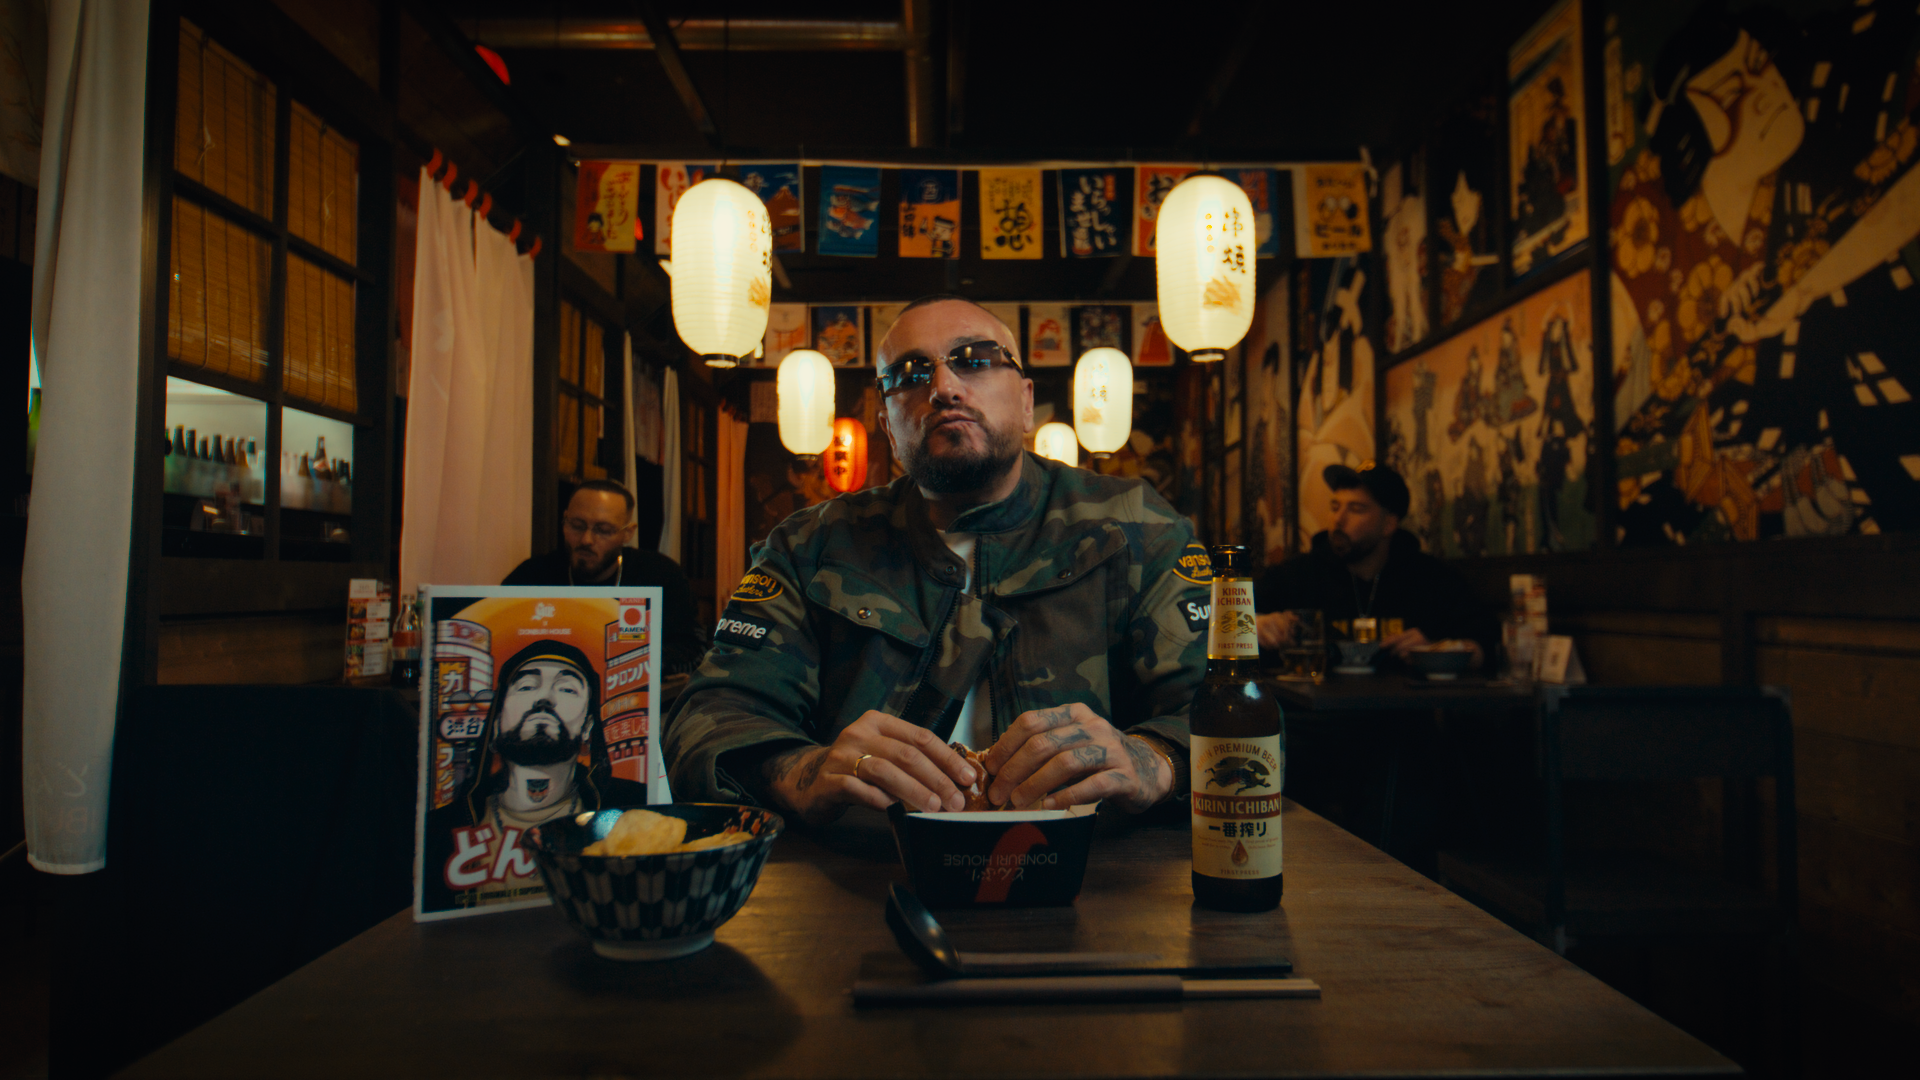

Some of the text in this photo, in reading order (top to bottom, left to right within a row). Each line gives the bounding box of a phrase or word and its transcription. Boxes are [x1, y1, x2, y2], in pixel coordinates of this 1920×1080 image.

[1222, 588, 1247, 596] KIRIN
[1218, 597, 1252, 606] ICHIBAN
[1187, 602, 1212, 621] Su
[447, 716, 486, 736] 渋谷
[1196, 743, 1277, 772] KIRIN PREMIUM BEER
[1195, 797, 1280, 815] KIRIN ICHIBAN
[943, 852, 1058, 867] DONBURI HOUSE
